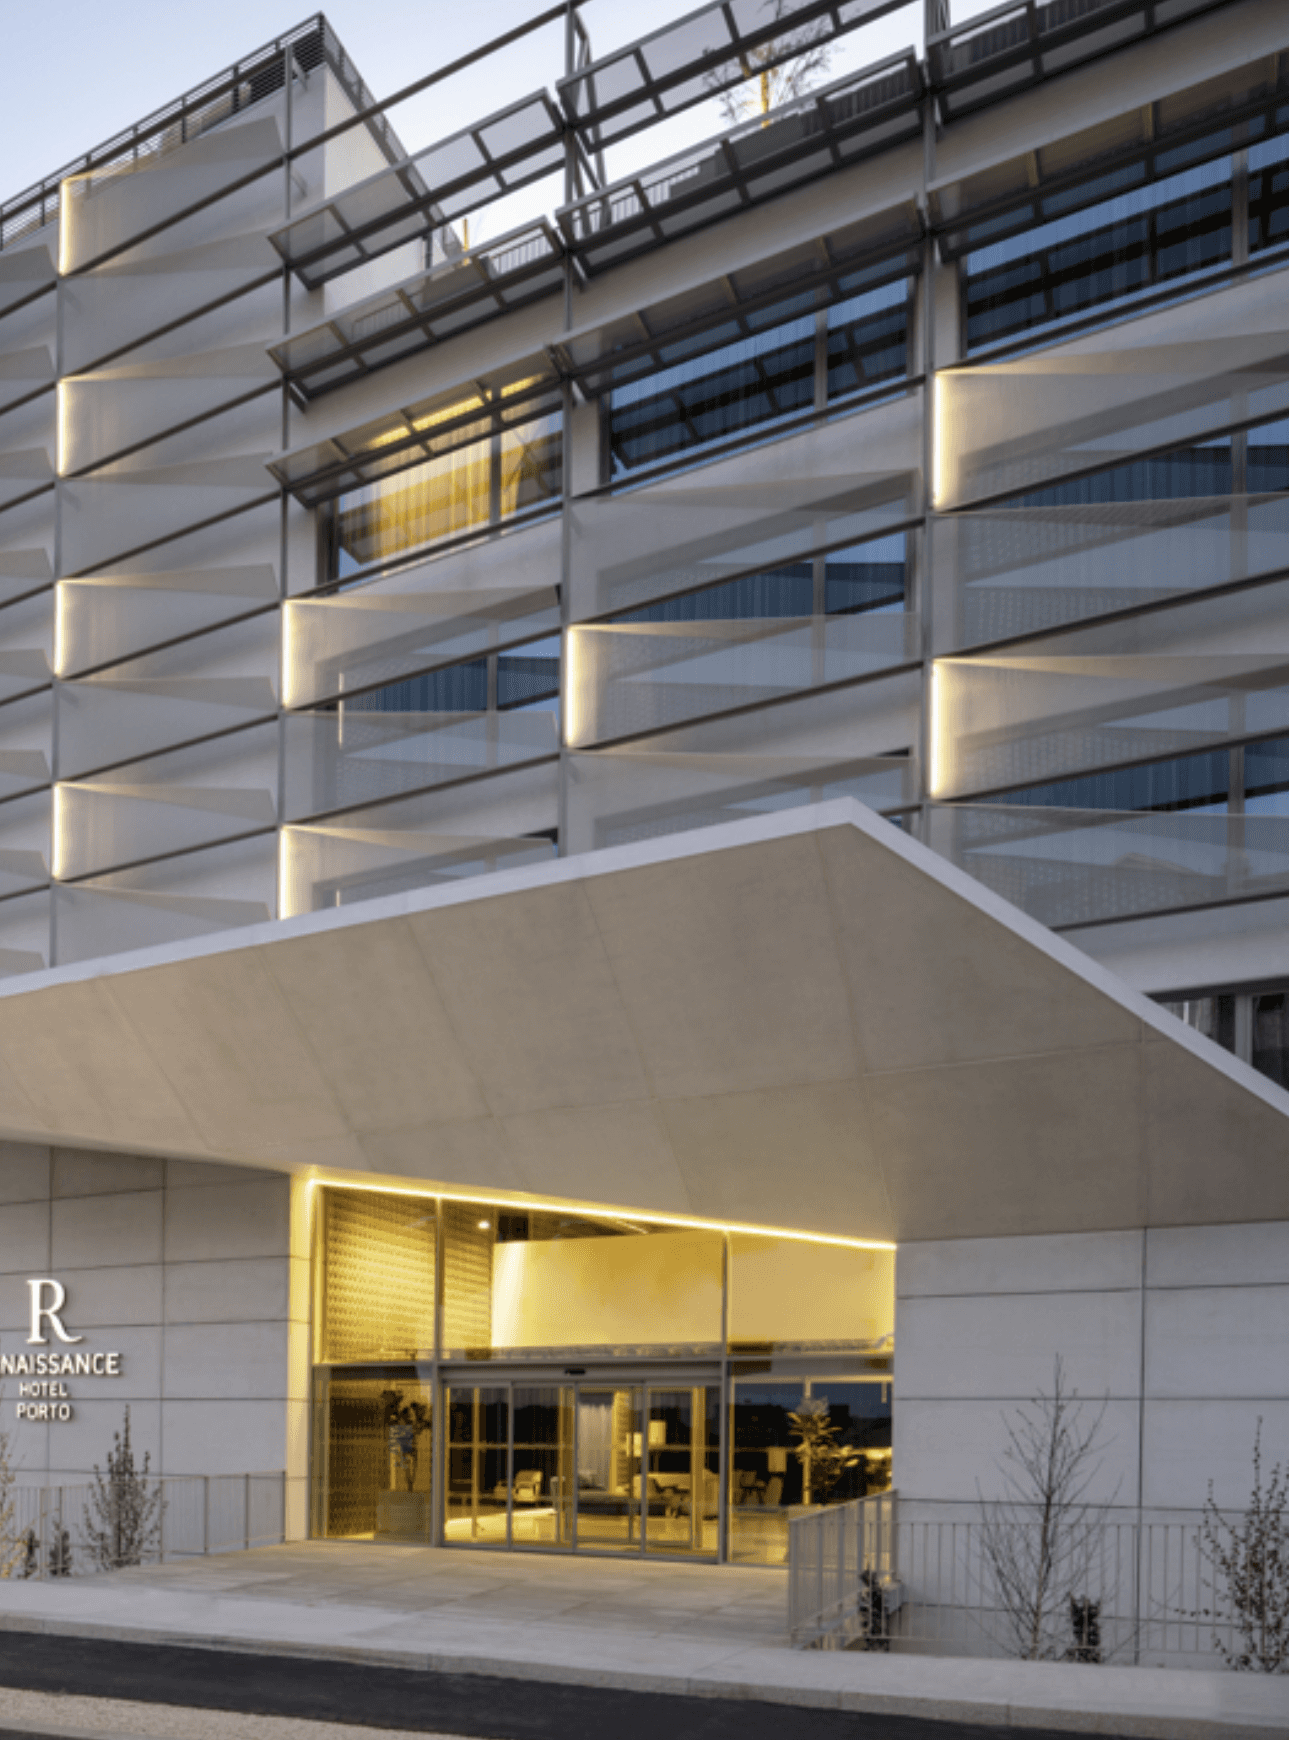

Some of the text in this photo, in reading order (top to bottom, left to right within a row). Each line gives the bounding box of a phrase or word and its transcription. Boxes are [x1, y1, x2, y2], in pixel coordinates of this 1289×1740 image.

[25, 1279, 83, 1345] R
[19, 1381, 68, 1397] HOTEL
[16, 1402, 71, 1420] PORTO
